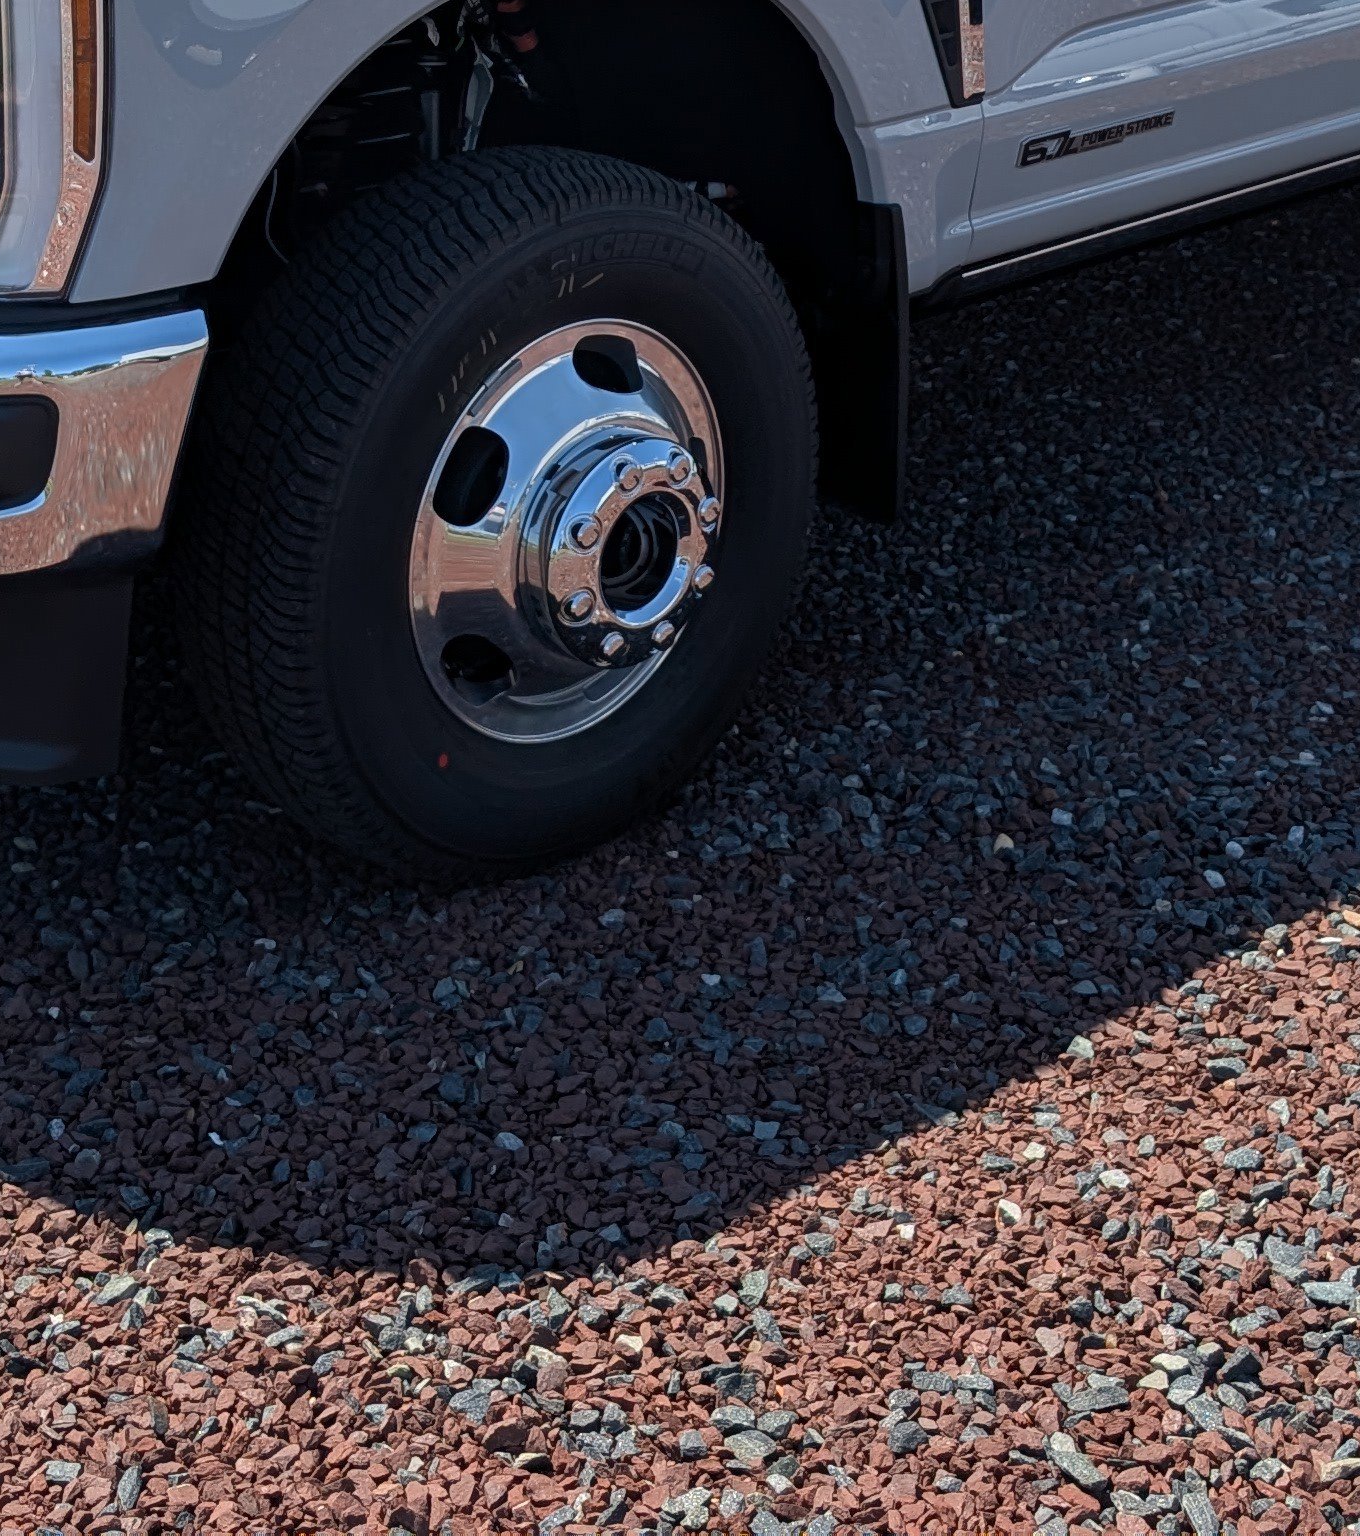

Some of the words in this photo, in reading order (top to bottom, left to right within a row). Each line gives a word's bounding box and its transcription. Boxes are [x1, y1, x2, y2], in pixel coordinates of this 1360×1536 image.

[1019, 129, 1079, 167] 6.7L
[1080, 124, 1124, 147] POWER
[1124, 111, 1176, 136] STROKE
[550, 231, 707, 276] MICHELIN
